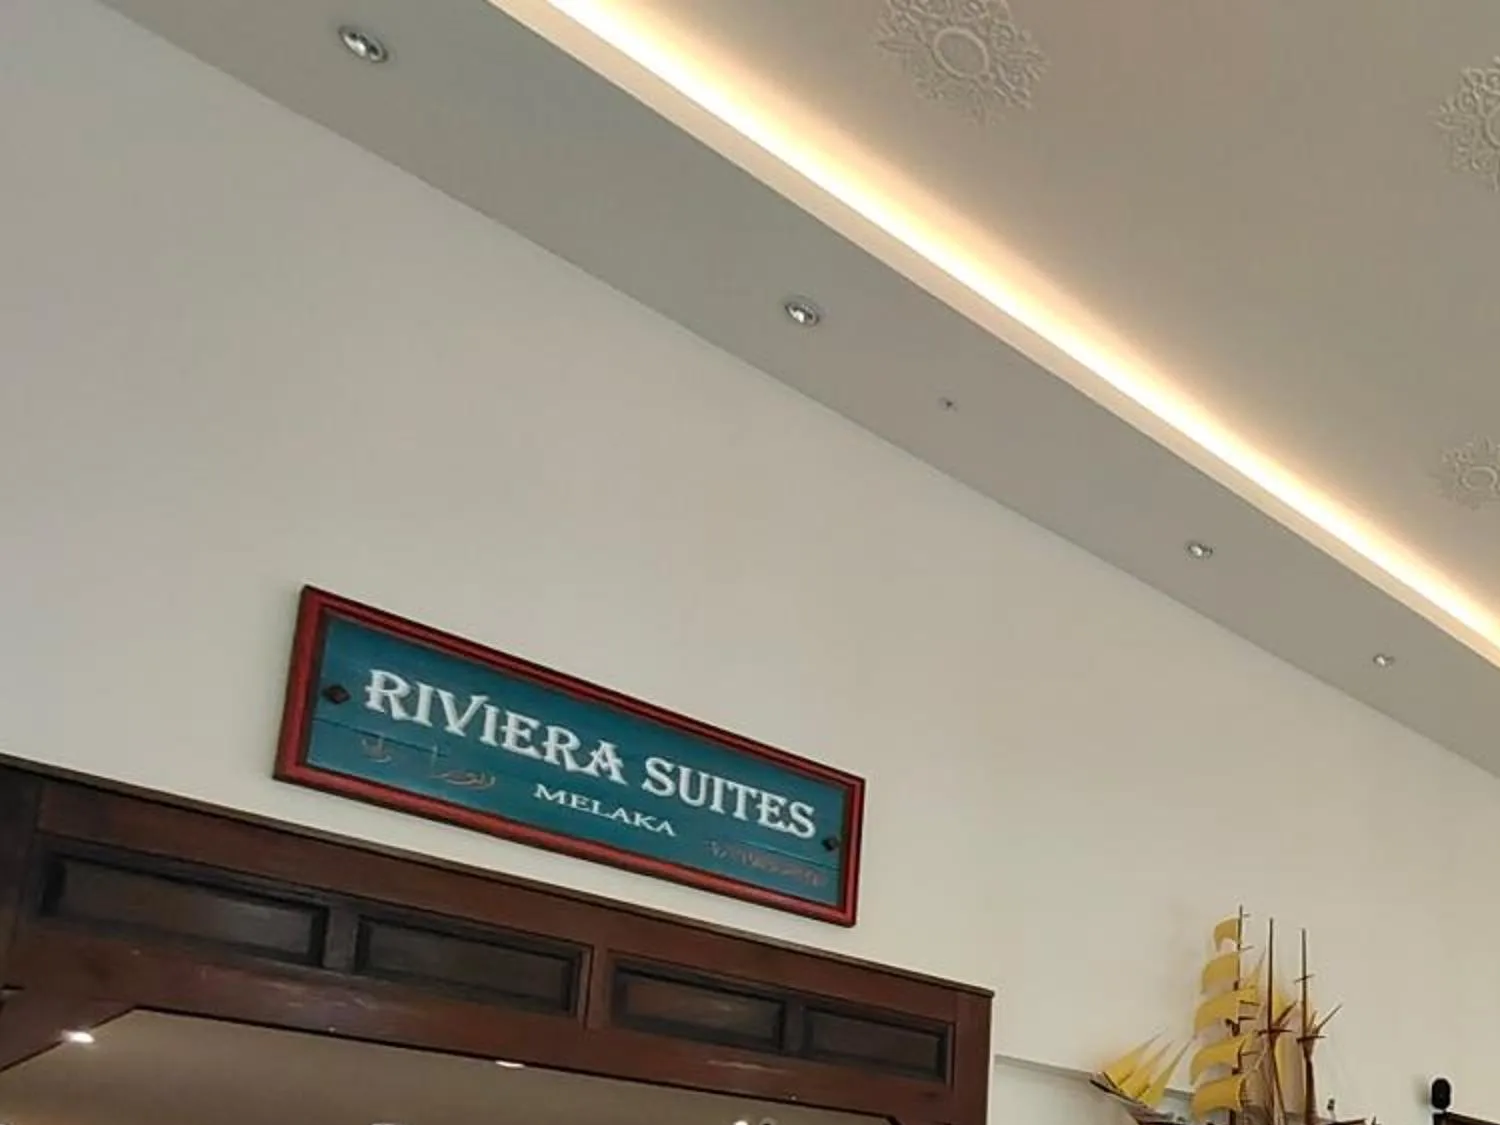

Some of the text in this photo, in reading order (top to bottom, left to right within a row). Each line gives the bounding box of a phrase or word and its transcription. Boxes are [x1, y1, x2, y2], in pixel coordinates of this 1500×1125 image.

[365, 669, 628, 786] RIVIERA
[641, 756, 817, 839] SUITES
[533, 783, 677, 837] MELAKA
